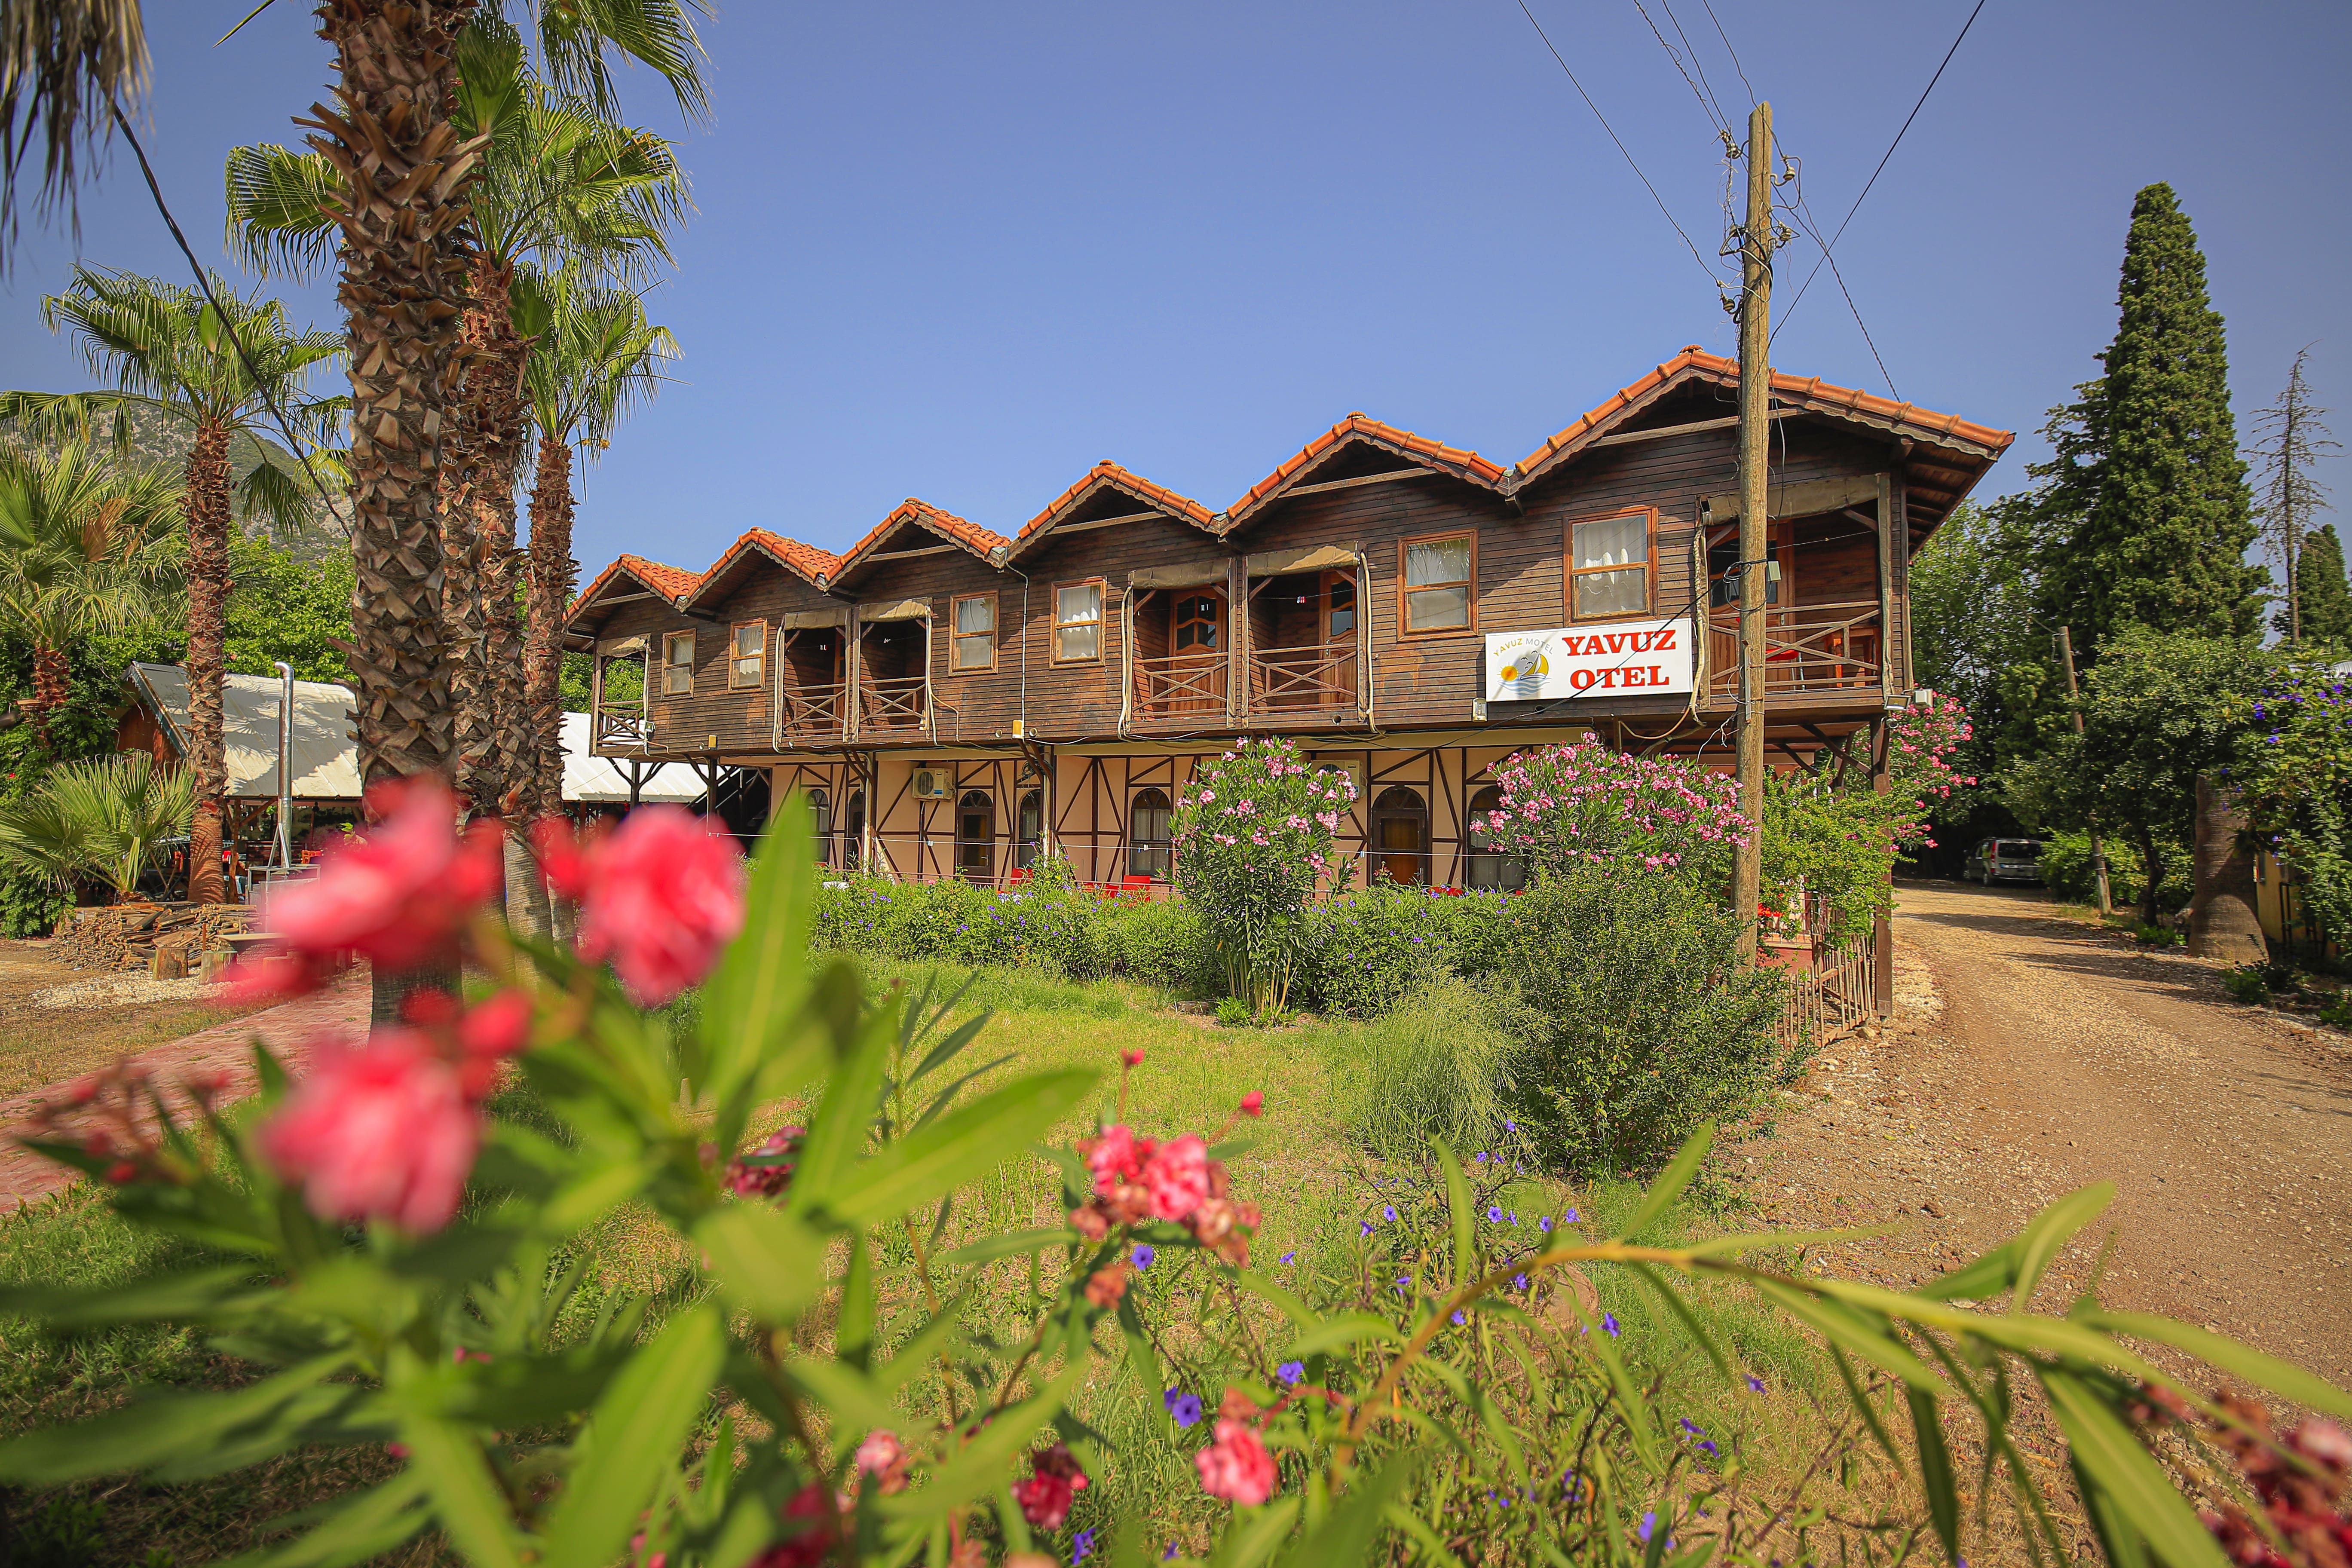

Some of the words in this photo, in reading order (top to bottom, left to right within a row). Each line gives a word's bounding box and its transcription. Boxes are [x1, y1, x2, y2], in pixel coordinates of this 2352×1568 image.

[1493, 638, 1522, 656] YAVUZ
[1525, 638, 1553, 654] MOTEL
[1562, 629, 1676, 656] YAVUZ
[1570, 665, 1669, 690] OTEL
